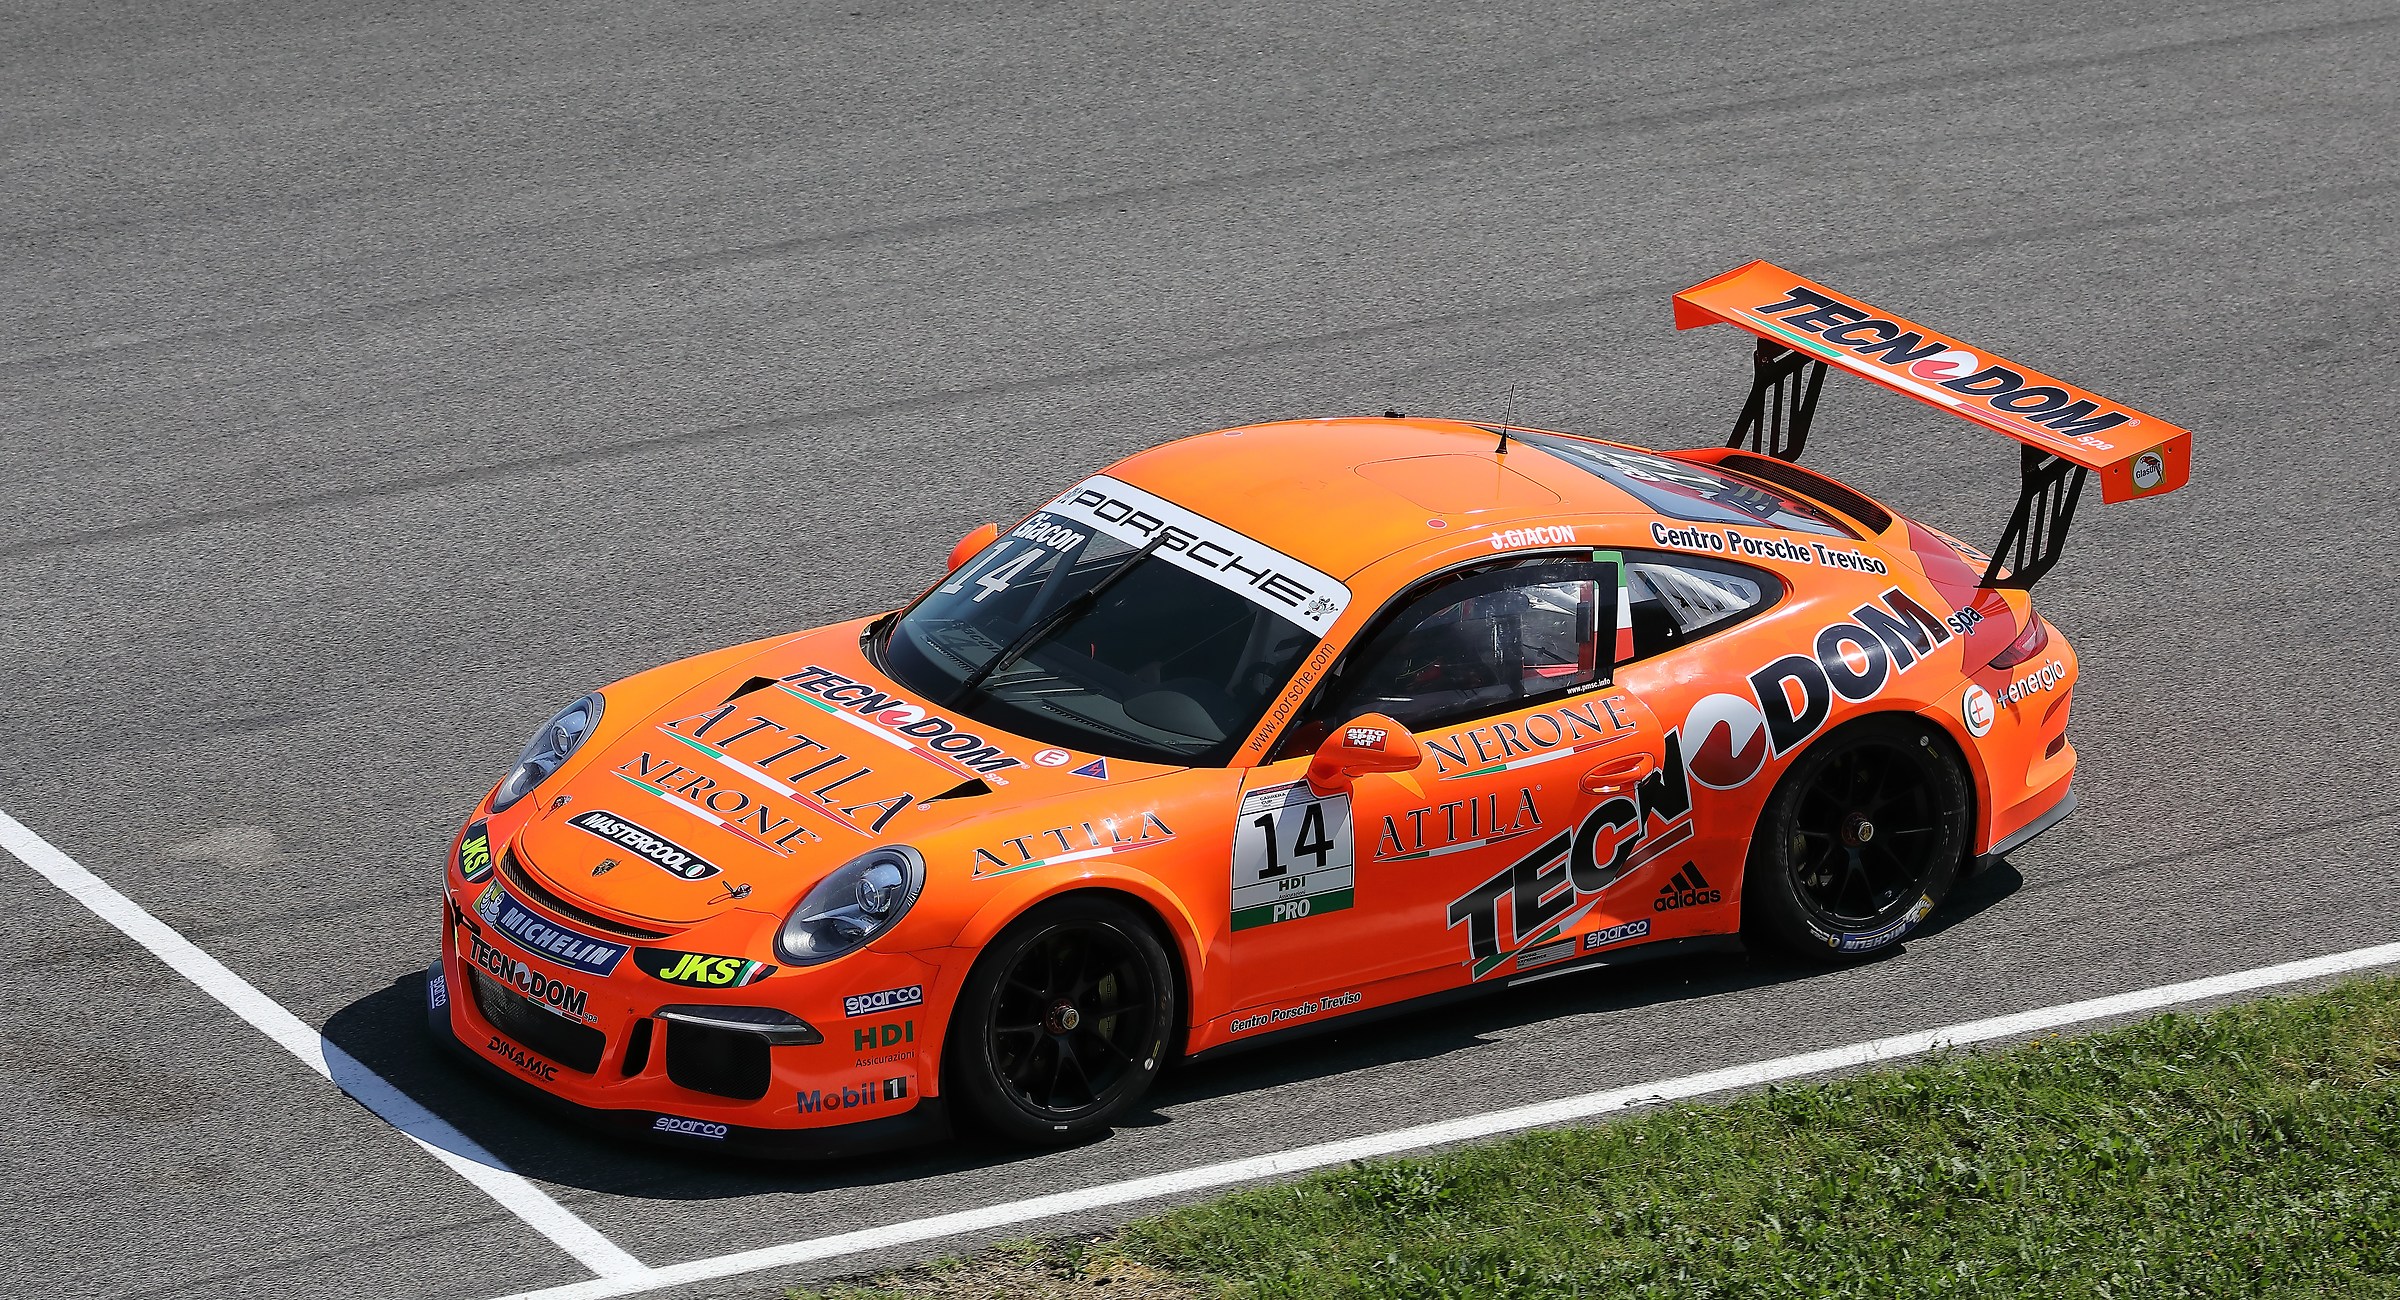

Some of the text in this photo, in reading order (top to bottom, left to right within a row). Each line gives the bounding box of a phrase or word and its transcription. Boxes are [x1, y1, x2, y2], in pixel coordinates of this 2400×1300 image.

[1754, 285, 2133, 450] TECNODOM spa
[1012, 512, 1086, 553] Giacon
[1068, 488, 1315, 608] PORSCHE
[1491, 525, 1576, 550] J.GIACON
[1650, 521, 1888, 576] Centro Porsche Treviso
[939, 540, 1046, 603] 14
[1947, 605, 1984, 637] spa
[1248, 640, 1336, 752] www.porsche.com
[1567, 678, 1611, 695] www.pmsc.info
[1347, 728, 1386, 736] AUTO
[1347, 733, 1382, 742] SPRI
[1424, 695, 1637, 774] NERONE
[661, 704, 918, 836] ATTILA
[984, 772, 1010, 786] spa
[618, 752, 819, 856] NERONE
[1375, 788, 1543, 858] ATTILA
[462, 835, 491, 873] JKS
[582, 813, 691, 870] MASTERCOOL
[973, 811, 1175, 876] ATTILA
[1254, 802, 1334, 880] 14
[1279, 876, 1306, 891] HDI
[1653, 887, 1721, 912] adidas
[1273, 899, 1311, 923] PRO
[500, 907, 617, 966] MICHELIN
[1586, 920, 1648, 947] sparco
[1843, 923, 1906, 950] MICHELIN
[660, 954, 743, 984] JKS
[431, 974, 447, 1009] sparco
[845, 985, 921, 1014] sparco
[584, 1012, 598, 1023] spa
[1230, 992, 1361, 1033] Centro Porsche Treviso
[854, 1020, 914, 1051] HDI
[486, 1036, 559, 1082] DINAMIC
[855, 1050, 915, 1067] Assicurazioni
[796, 1082, 875, 1114] Mobil
[653, 1116, 727, 1138] sparco
